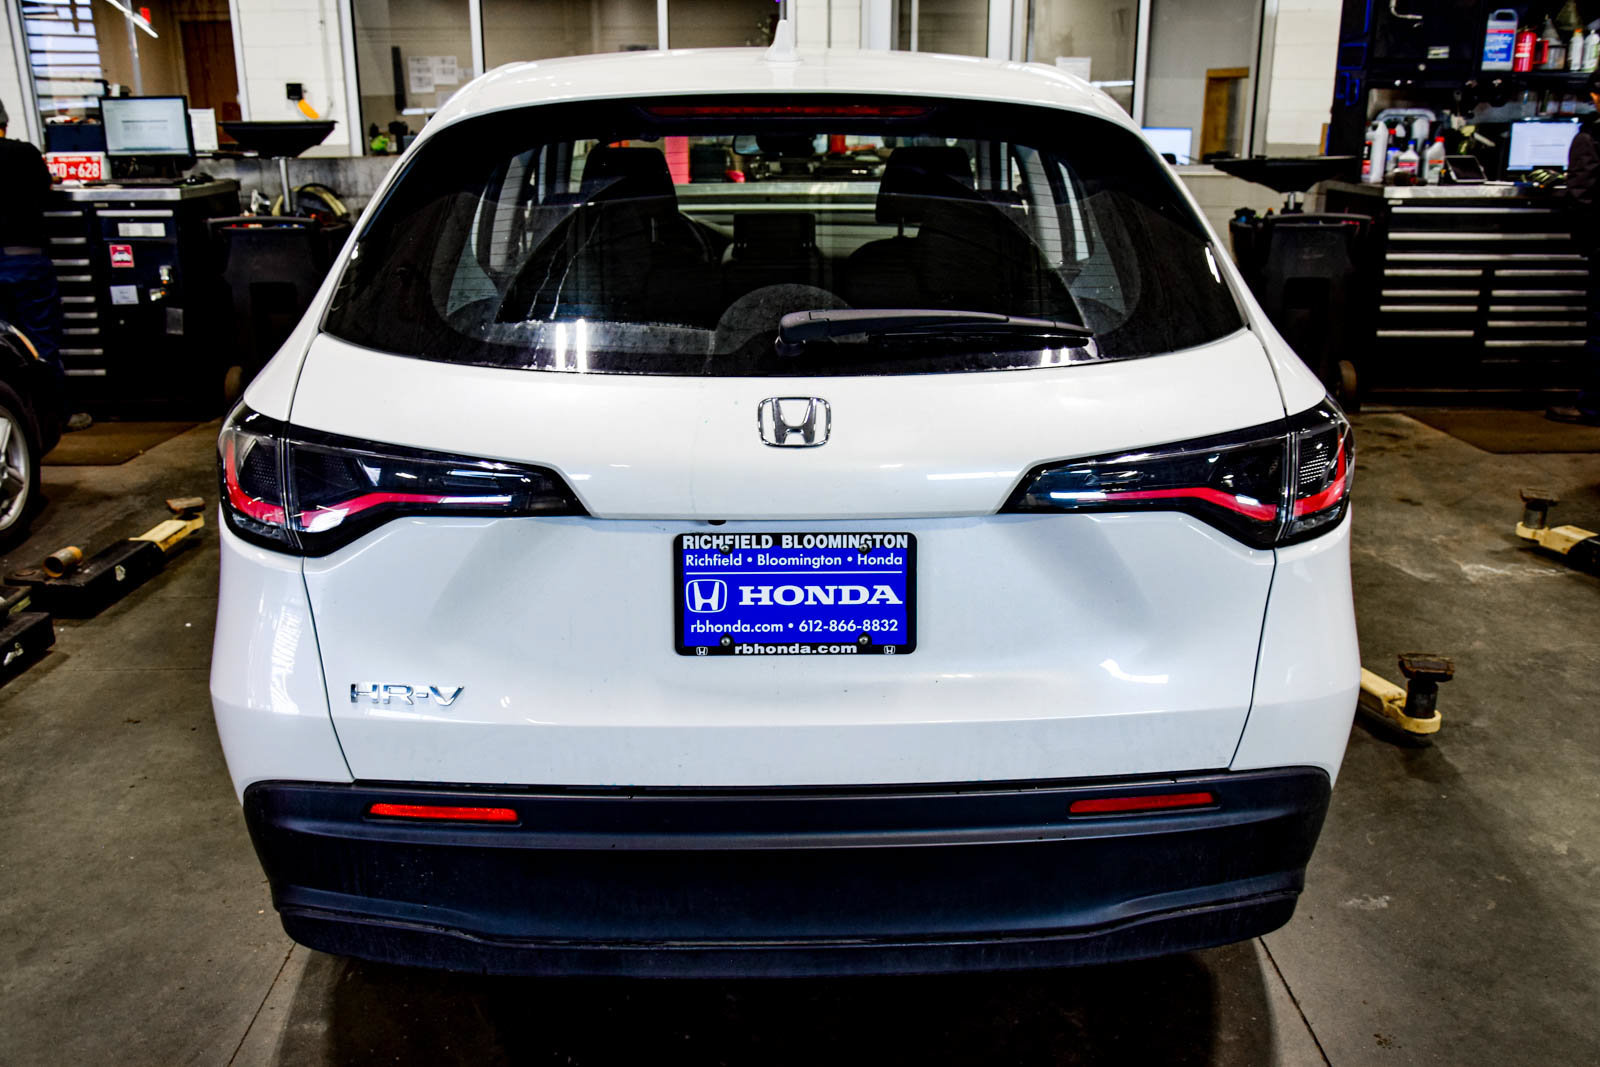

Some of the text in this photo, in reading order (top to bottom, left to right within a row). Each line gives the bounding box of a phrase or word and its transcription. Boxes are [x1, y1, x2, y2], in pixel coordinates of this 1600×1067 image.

[77, 163, 100, 178] 628
[682, 534, 908, 549] RICHFIELD BLOOMINGTON
[685, 553, 903, 569] Richfield Bloomington Honda
[738, 585, 903, 606] HONDA
[690, 619, 898, 633] rbhonda.com 612-866-8832
[734, 644, 857, 655] rbhonda.com
[350, 683, 465, 706] HR-V
